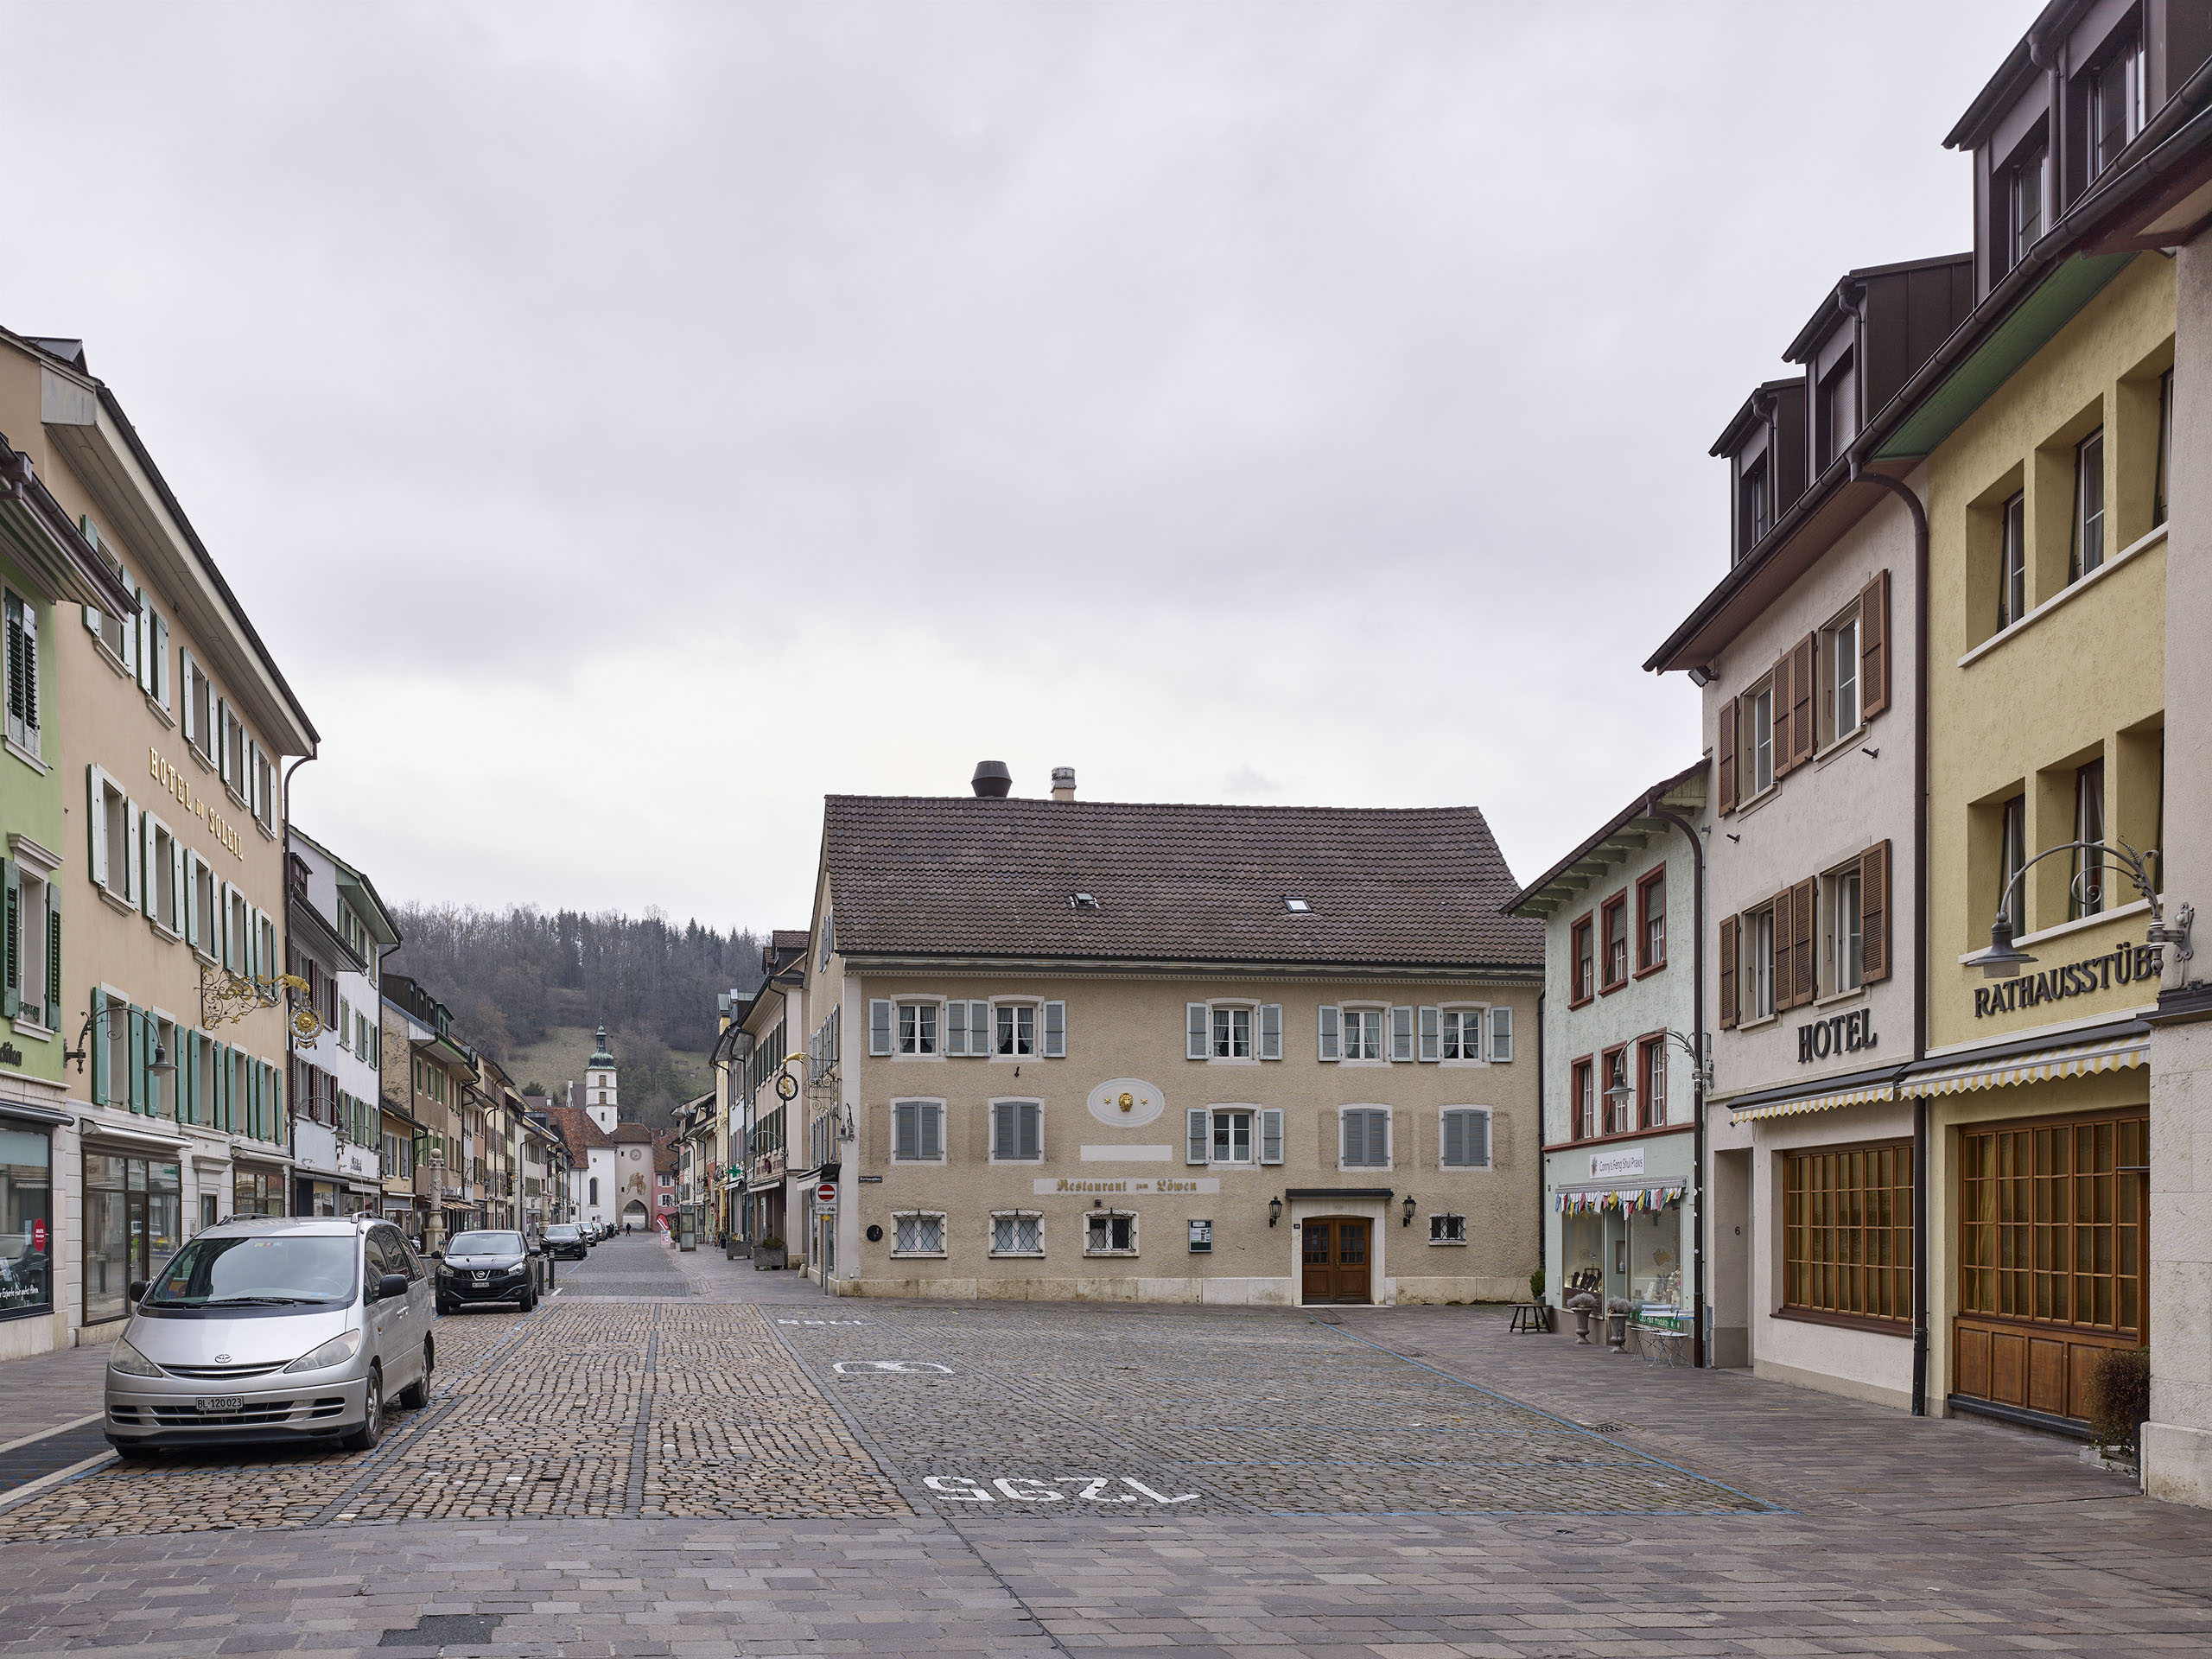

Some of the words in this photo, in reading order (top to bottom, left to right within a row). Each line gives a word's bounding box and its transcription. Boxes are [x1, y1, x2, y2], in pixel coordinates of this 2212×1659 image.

[149, 747, 192, 811] HOTEL
[195, 798, 205, 820] DU
[208, 807, 244, 861] SOLEIL
[1797, 1007, 1878, 1064] HOTEL
[1056, 1179, 1127, 1192] Restaurant
[1156, 1179, 1197, 1192] Löwen
[1734, 1226, 1741, 1236] 6
[922, 1475, 1203, 1504] 1295
